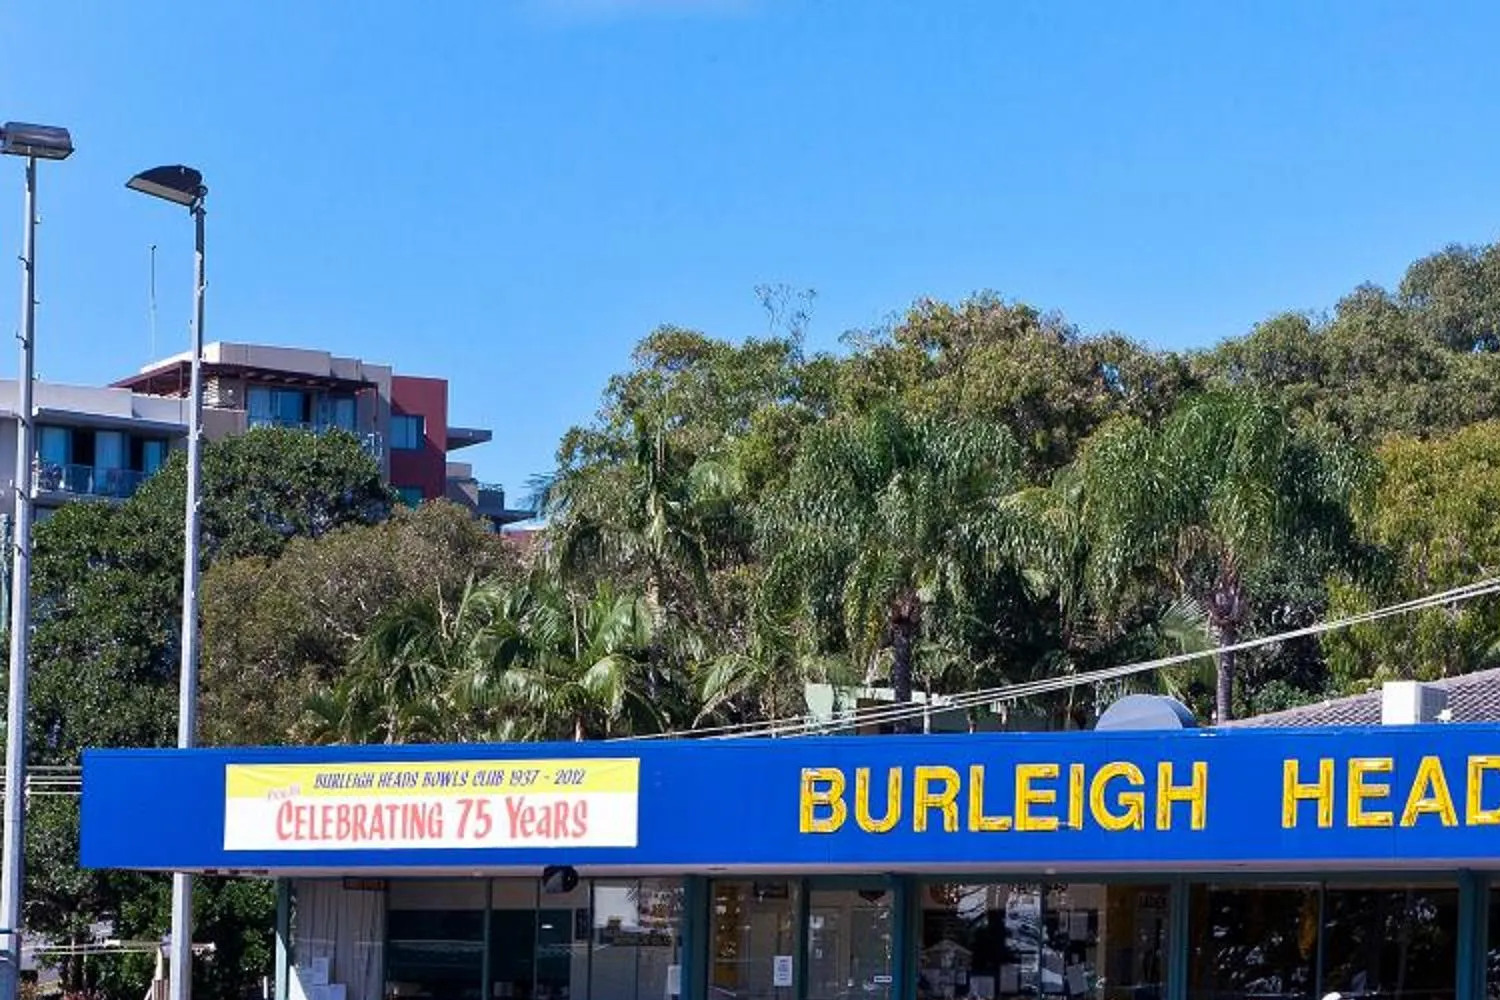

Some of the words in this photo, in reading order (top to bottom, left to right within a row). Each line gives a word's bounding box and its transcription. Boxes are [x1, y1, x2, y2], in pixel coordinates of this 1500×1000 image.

[313, 772, 375, 789] BURLEIGH
[378, 771, 419, 788] HEADS
[422, 769, 470, 788] BOWLS
[472, 769, 505, 786] CLUB
[509, 769, 541, 786] 1937
[553, 768, 587, 785] 2012
[798, 761, 1207, 833] BURLEIGH
[276, 799, 443, 842] CELEBRATING
[456, 798, 493, 840] 75
